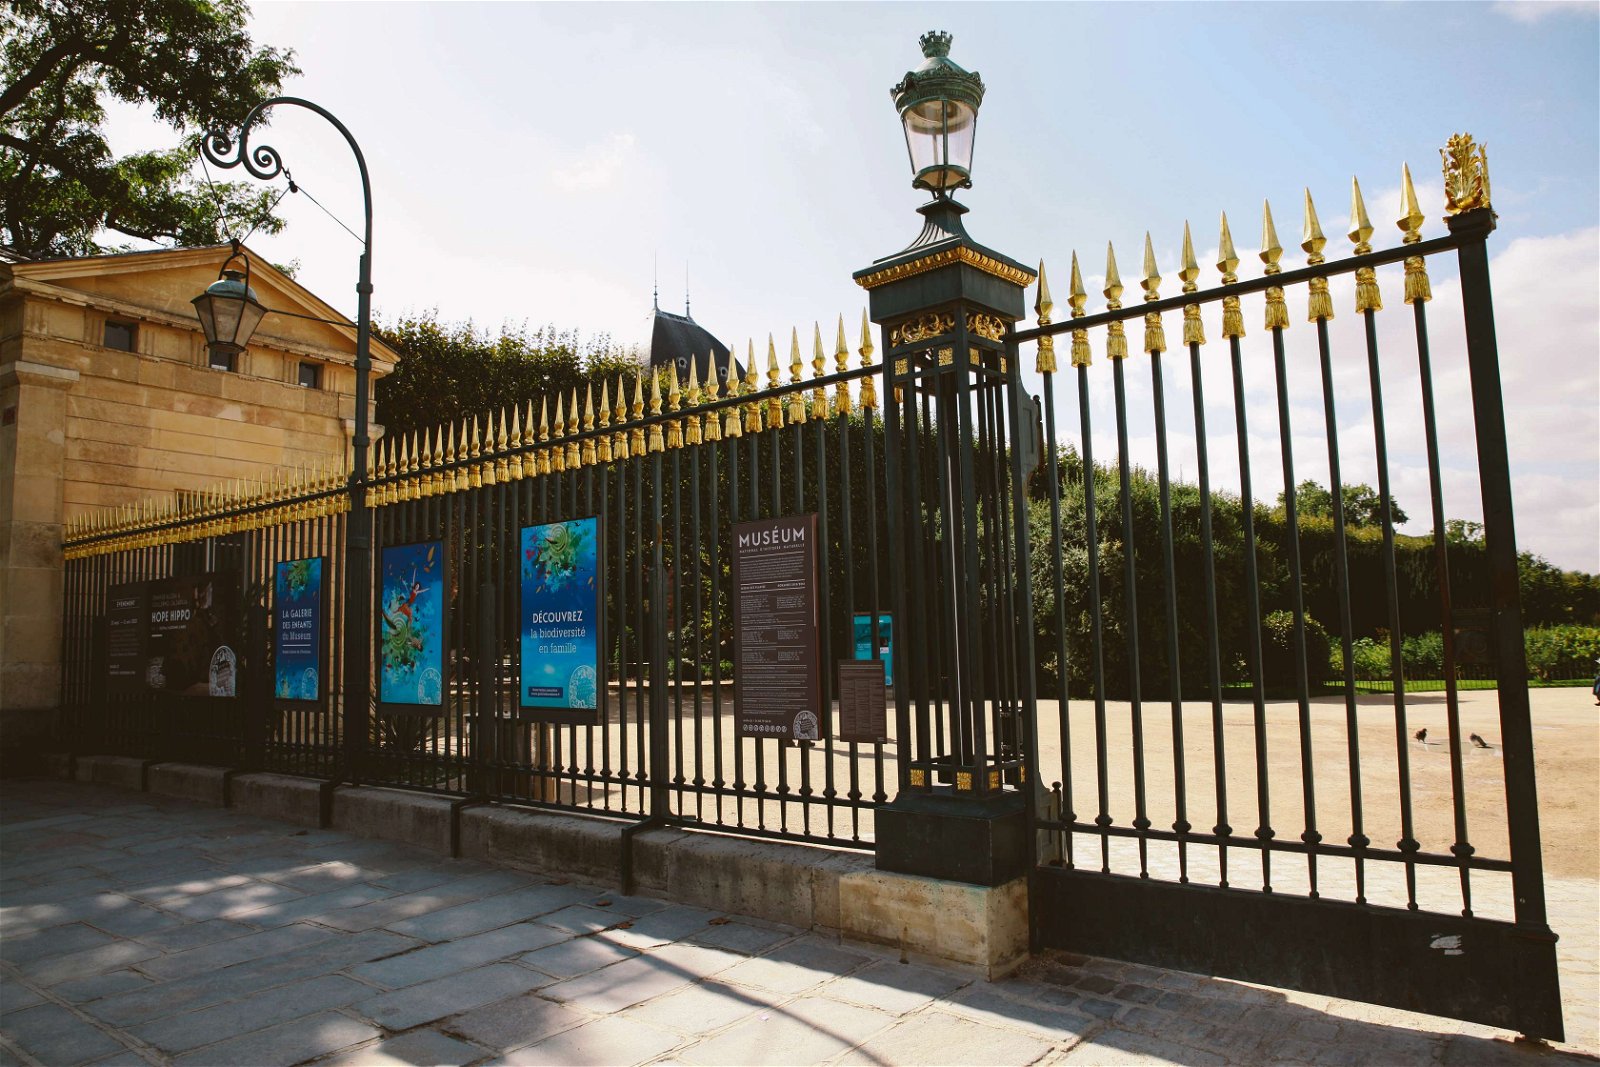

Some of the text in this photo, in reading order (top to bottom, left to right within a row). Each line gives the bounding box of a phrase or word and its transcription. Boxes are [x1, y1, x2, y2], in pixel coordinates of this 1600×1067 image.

[739, 525, 805, 548] MUSÉUM
[151, 610, 169, 623] HOPE
[170, 608, 191, 622] HIPPO
[282, 608, 313, 619] LA GALERIE
[532, 610, 583, 624] DÉCOUVREZ
[282, 620, 312, 630] DES ENFANTS
[530, 626, 586, 639] la biodiversité
[538, 643, 577, 654] en famille
